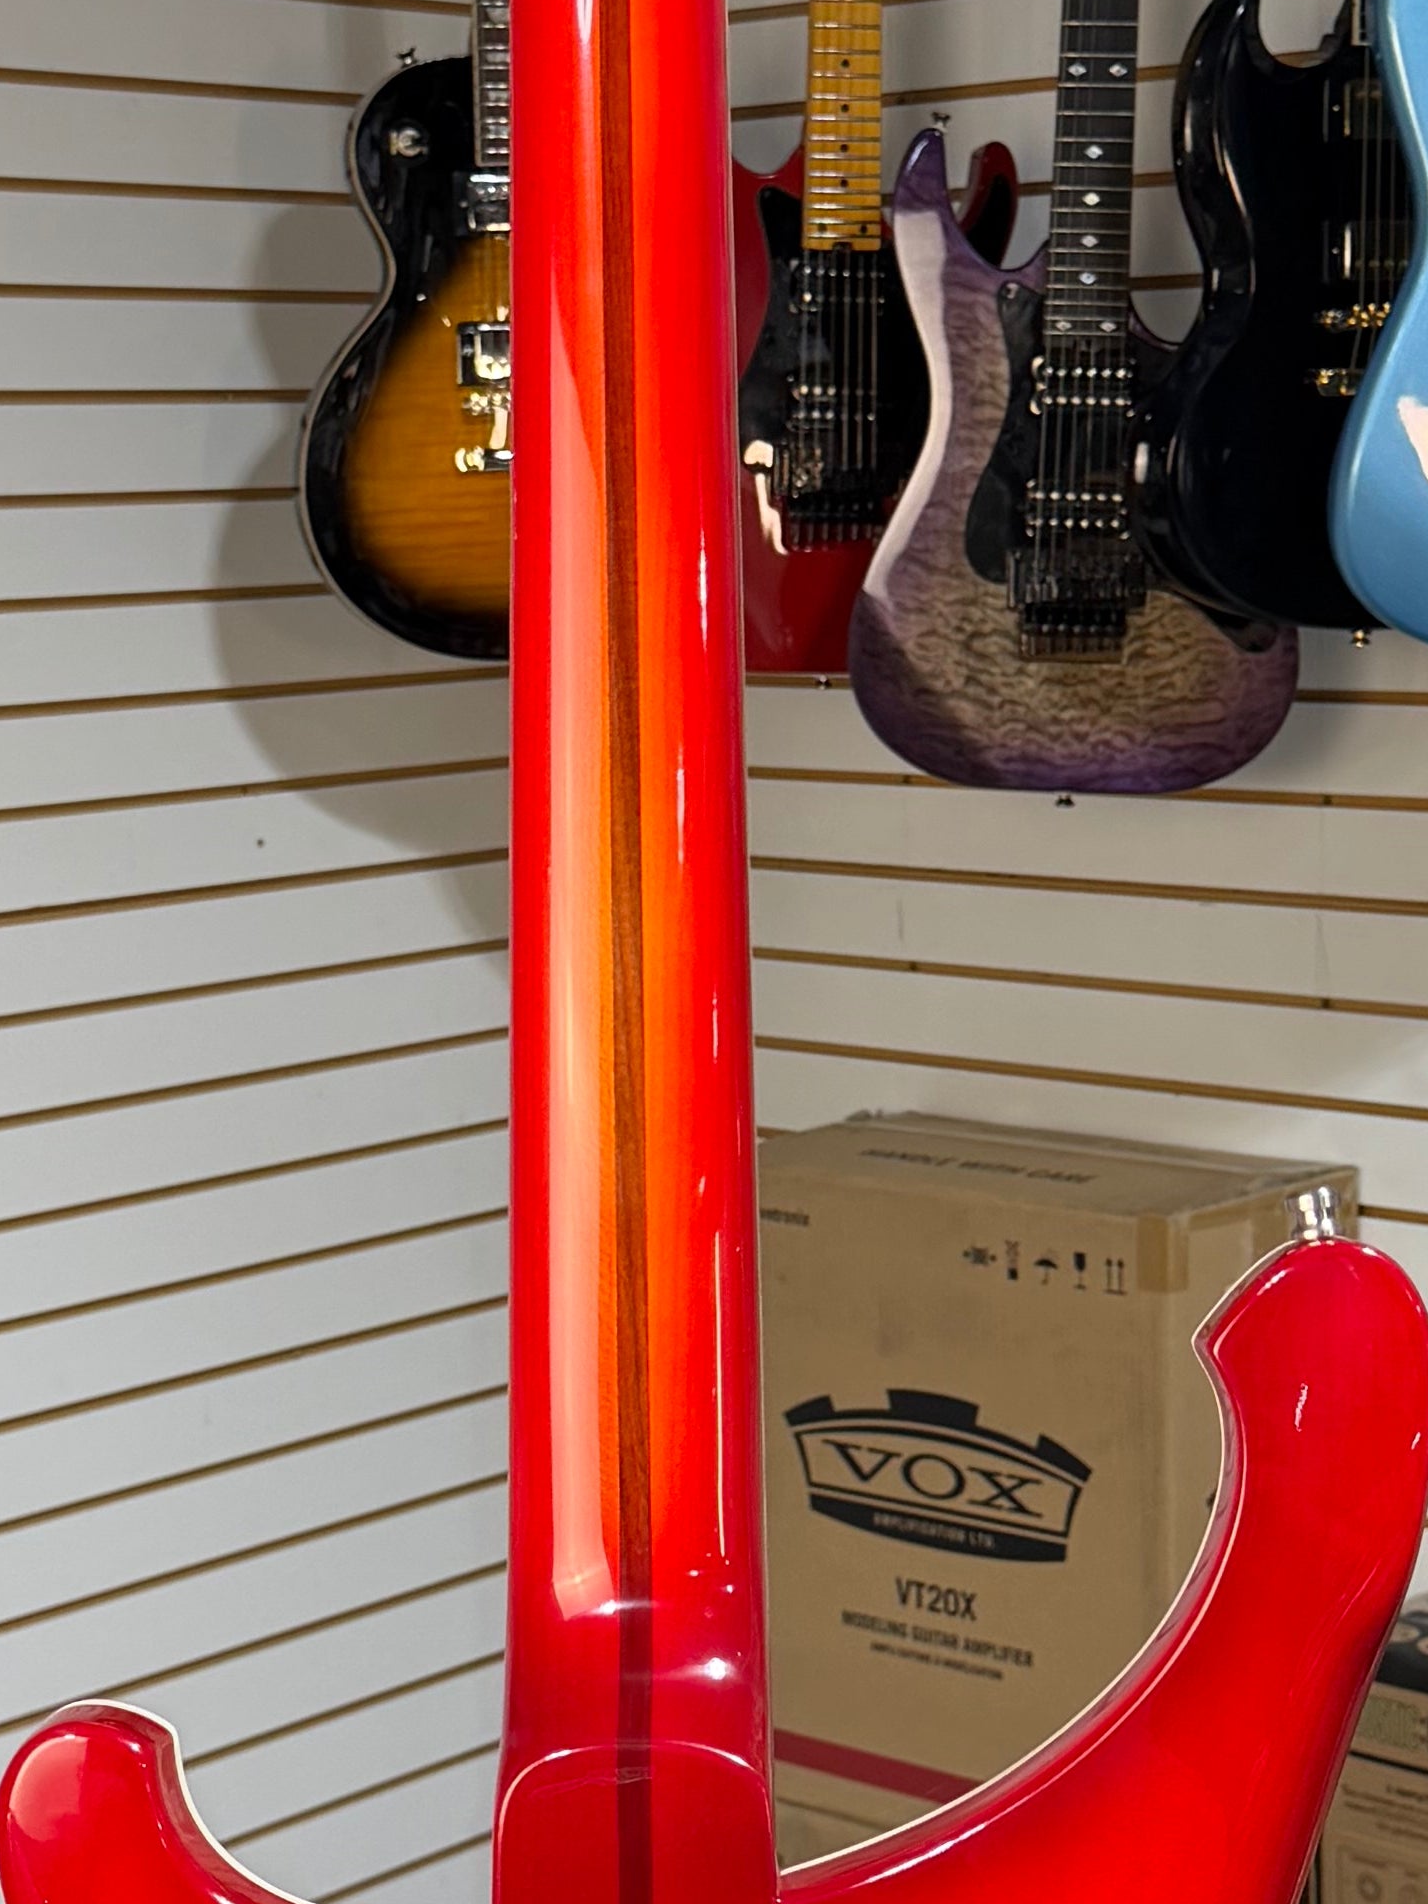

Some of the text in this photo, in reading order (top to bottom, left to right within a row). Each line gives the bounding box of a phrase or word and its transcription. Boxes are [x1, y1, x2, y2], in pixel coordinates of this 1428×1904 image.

[821, 1438, 1044, 1519] VOX
[895, 1575, 977, 1622] VT20X
[911, 1624, 959, 1650] GUITAR
[963, 1636, 1035, 1669] AMPLIFIER
